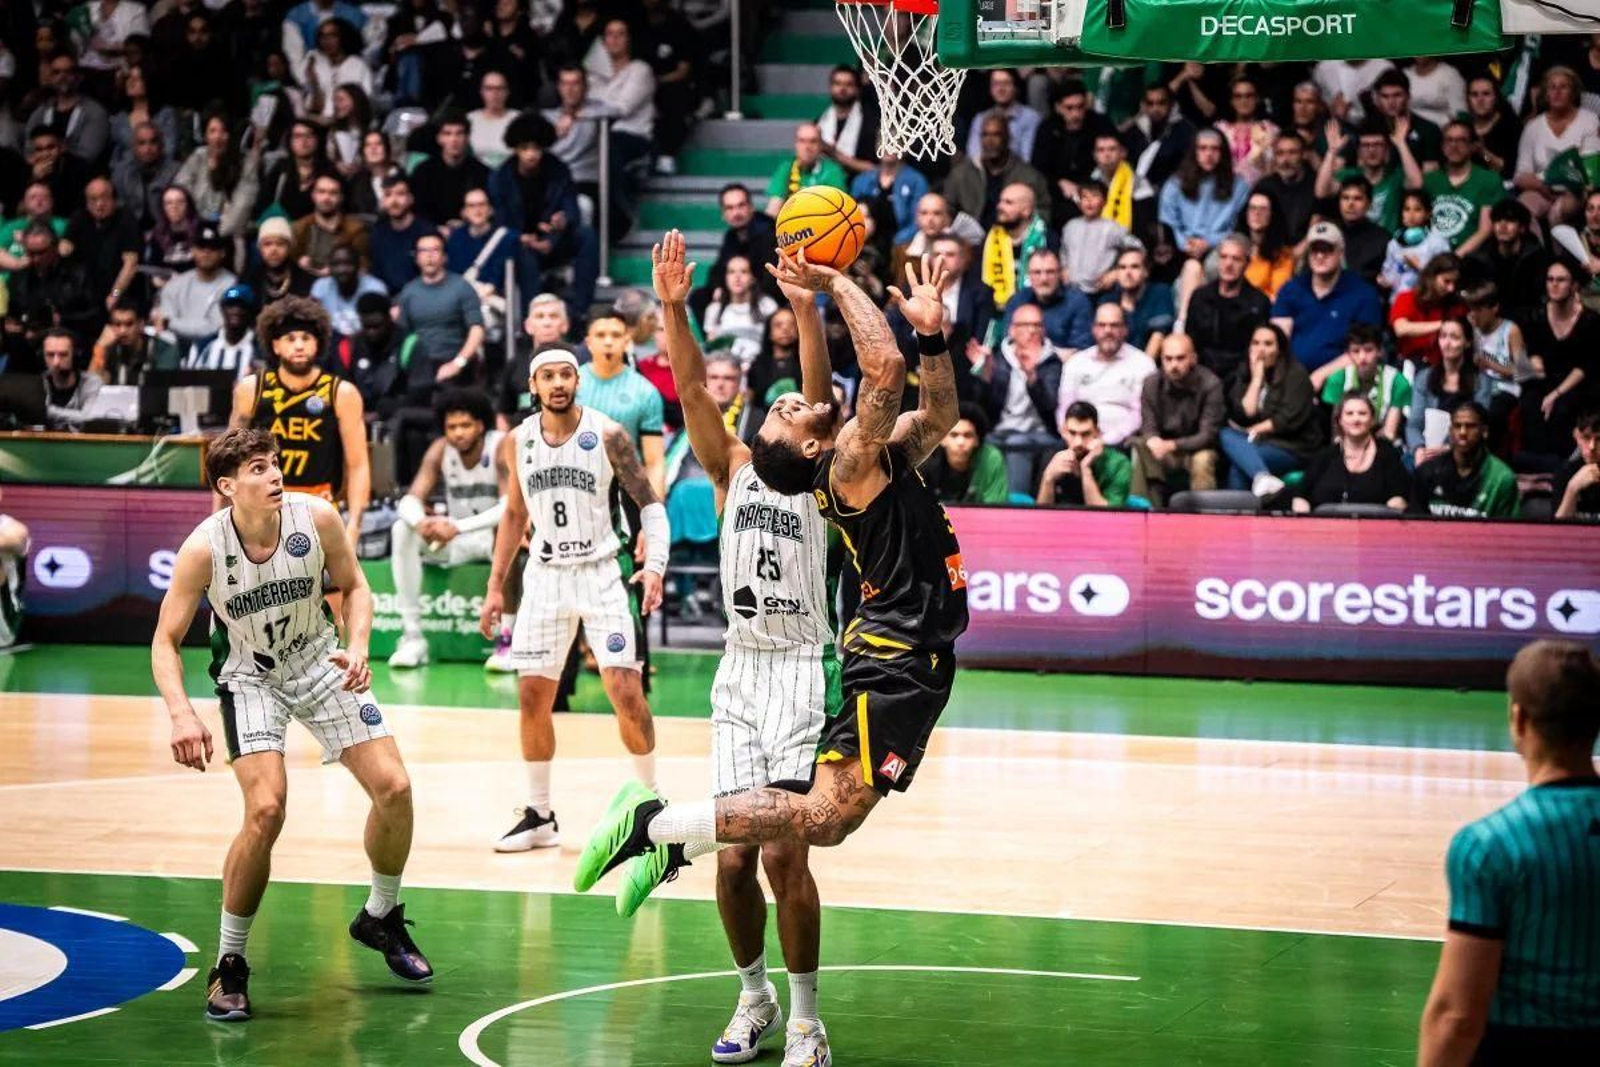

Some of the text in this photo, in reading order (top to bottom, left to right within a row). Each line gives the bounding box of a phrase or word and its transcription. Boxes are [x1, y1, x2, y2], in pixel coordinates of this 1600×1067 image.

[270, 417, 323, 441] AEK
[281, 450, 309, 476] 77
[553, 501, 568, 527] 8
[558, 540, 592, 552] GTM
[756, 546, 781, 581] 25
[1194, 574, 1537, 631] scorestars
[263, 615, 291, 649] 17
